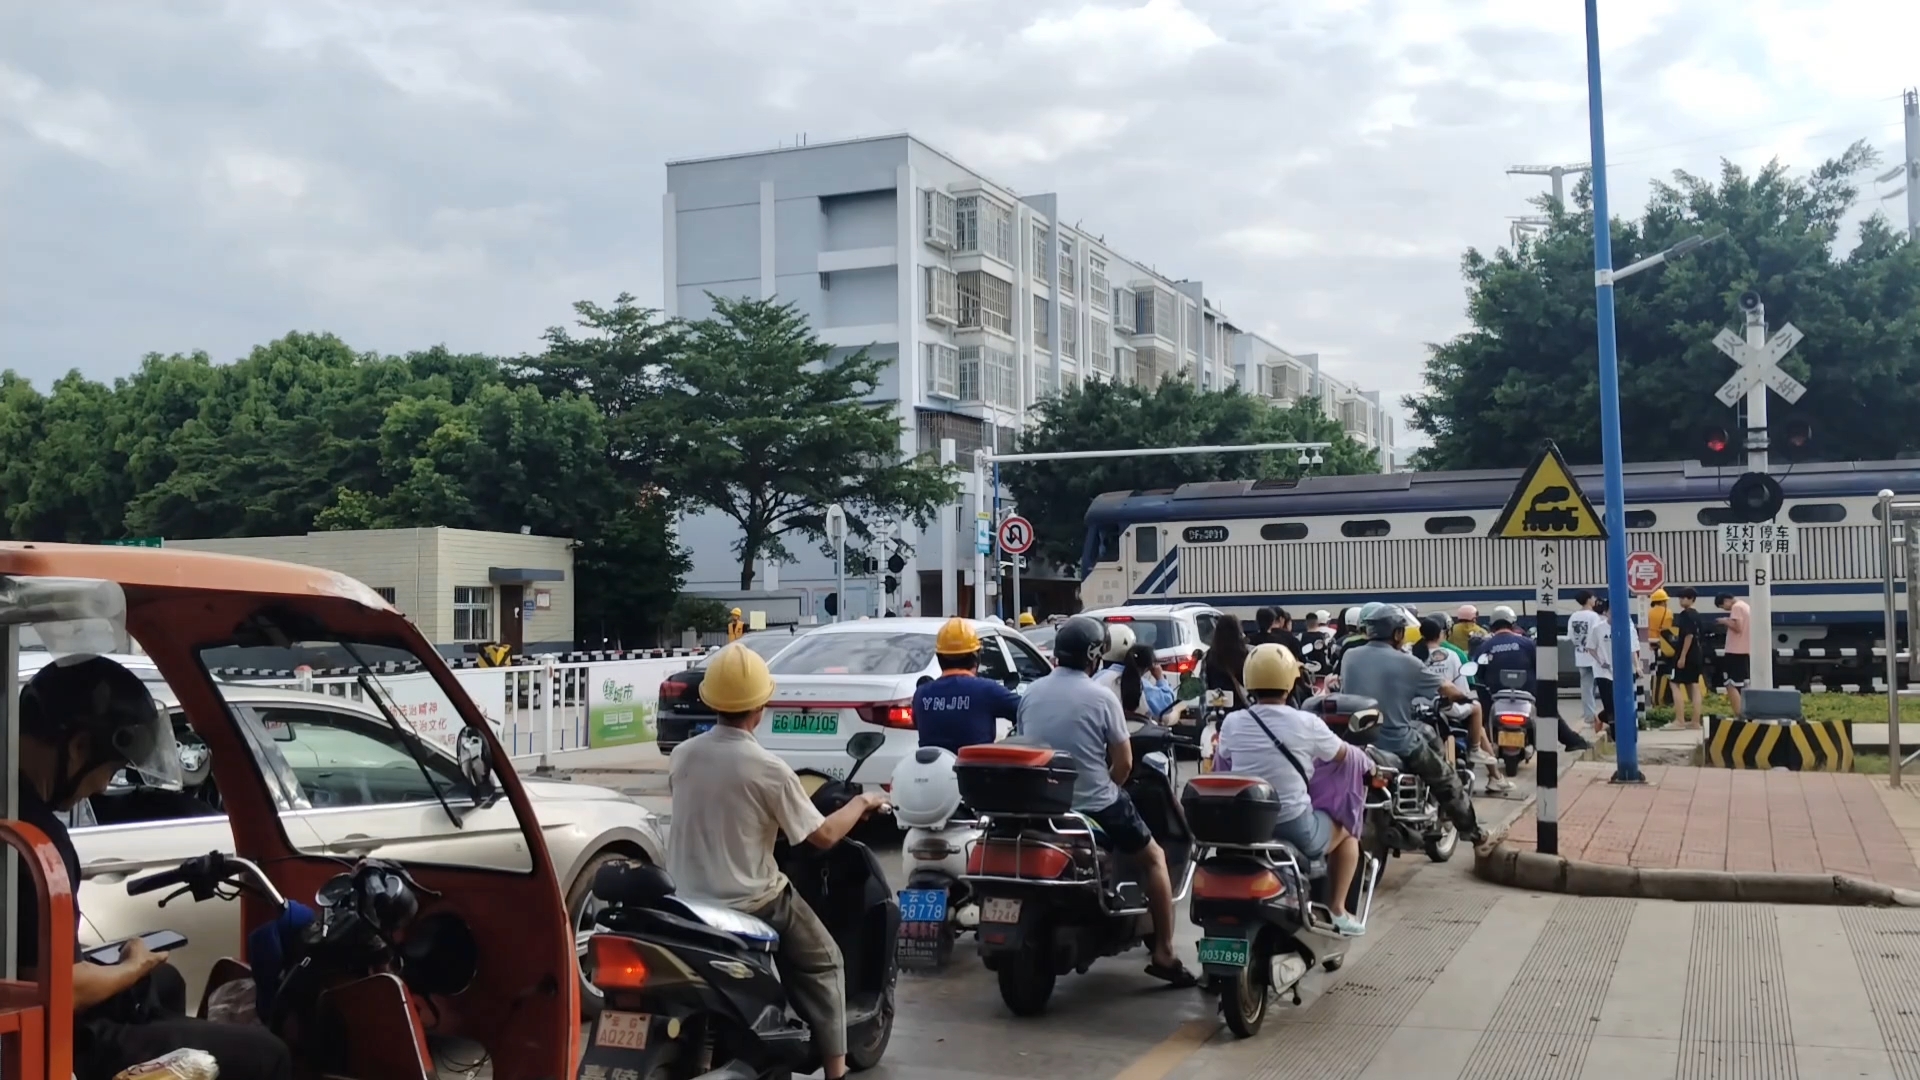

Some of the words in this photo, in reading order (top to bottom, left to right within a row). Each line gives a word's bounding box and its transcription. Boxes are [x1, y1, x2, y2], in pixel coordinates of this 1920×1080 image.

[1725, 524, 1790, 539] 红灯停车
[1725, 538, 1790, 554] 灭灯停用
[1540, 543, 1555, 607] 小心火车
[1628, 559, 1659, 587] 停
[1755, 568, 1767, 586] B
[922, 695, 970, 711] YNJH
[793, 714, 837, 731] DA7105
[900, 904, 943, 919] 58778
[1201, 949, 1245, 963] 0037898
